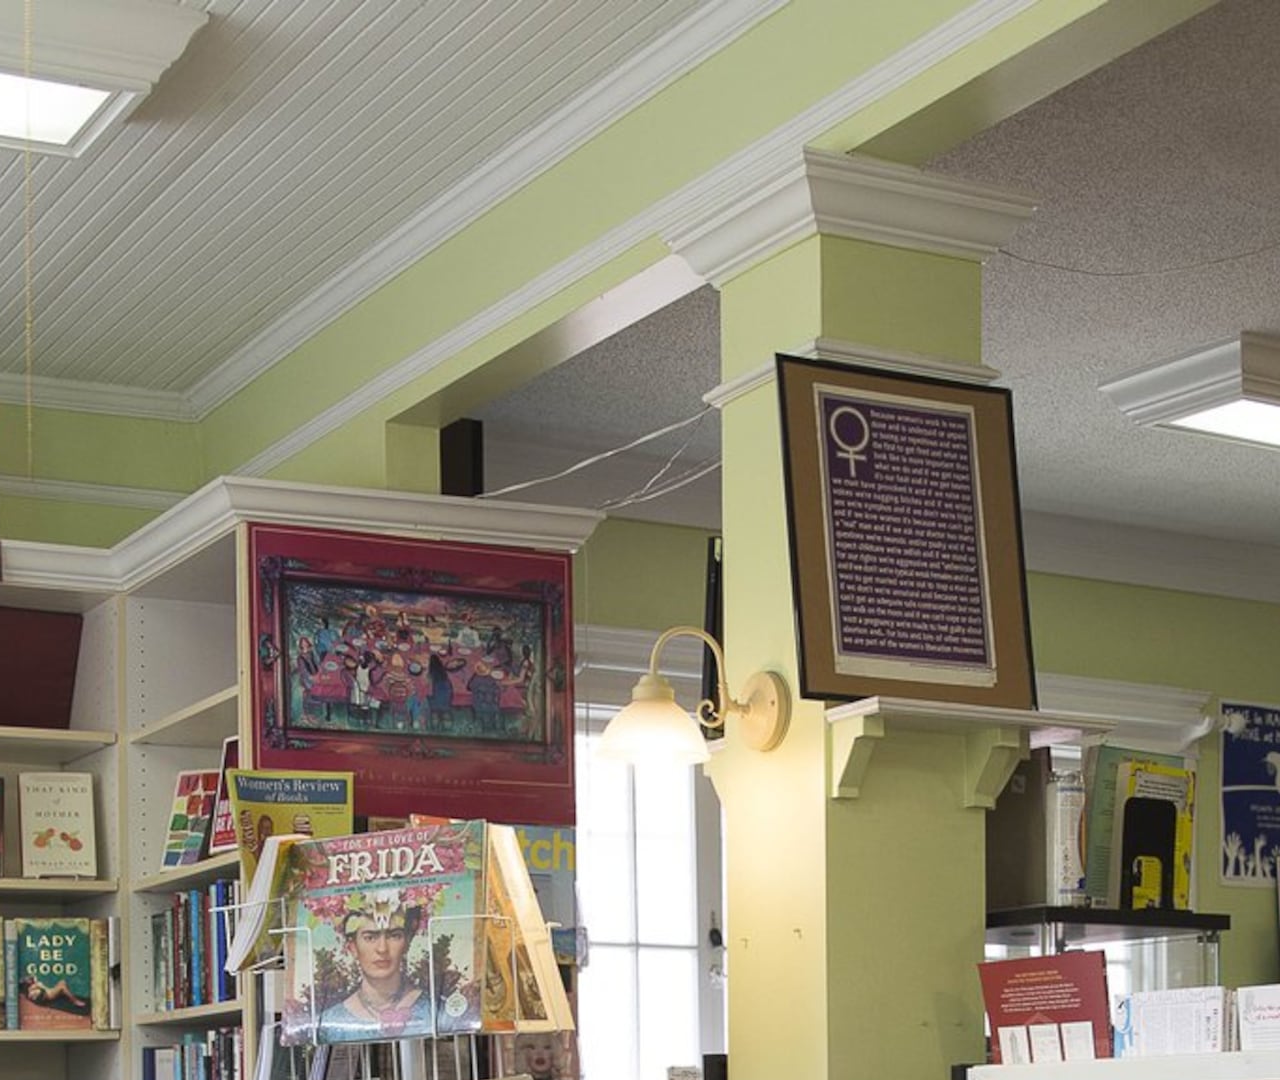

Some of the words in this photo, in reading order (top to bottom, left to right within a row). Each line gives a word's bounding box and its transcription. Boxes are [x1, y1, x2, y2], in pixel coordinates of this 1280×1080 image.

[237, 775, 291, 792] Women's
[292, 779, 341, 792] Review
[389, 834, 414, 846] LOVE
[327, 844, 444, 885] FRIDA
[26, 934, 78, 948] LADY
[40, 950, 63, 961] BE
[26, 962, 79, 975] GOOD
